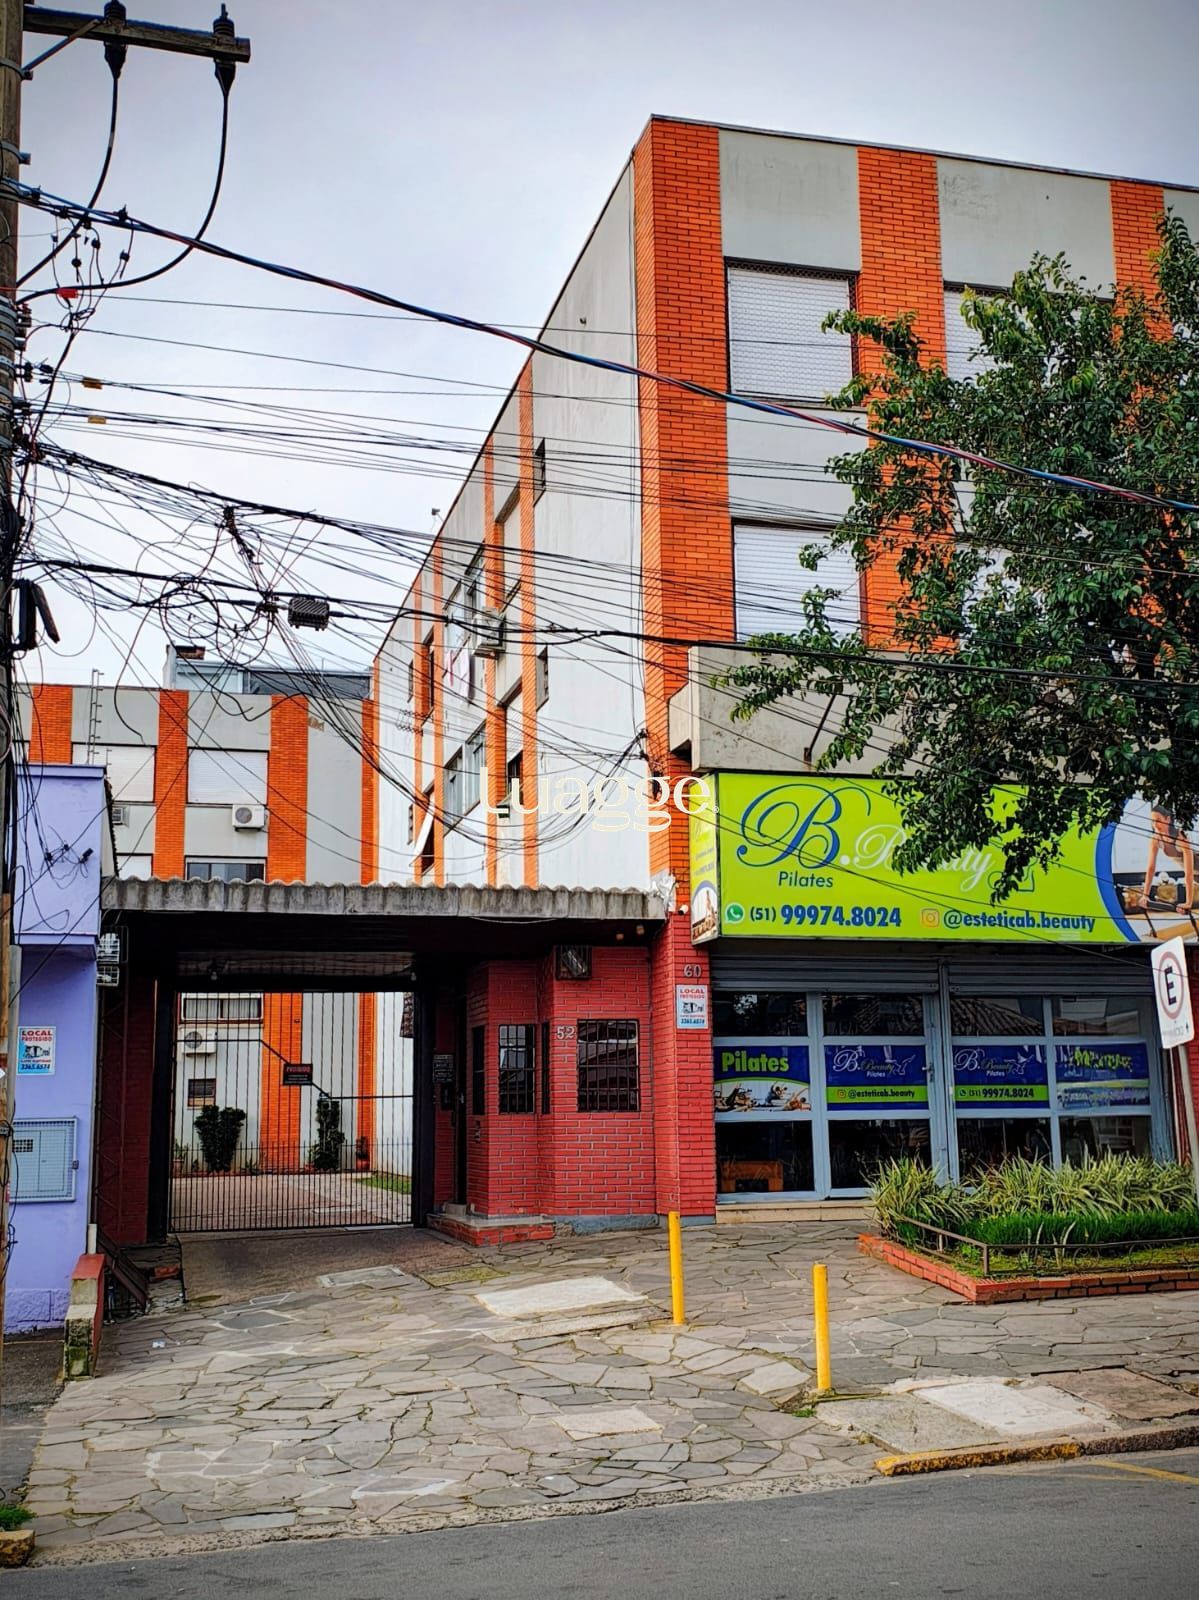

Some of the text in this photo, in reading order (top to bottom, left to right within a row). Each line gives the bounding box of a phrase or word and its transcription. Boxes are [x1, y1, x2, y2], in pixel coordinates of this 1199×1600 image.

[778, 870, 833, 888] Pilates
[750, 904, 902, 927] (51) 99974.8024
[943, 910, 1095, 933] @esteticab.beauty
[684, 963, 701, 978] 60
[1164, 966, 1177, 1006] E
[557, 1025, 575, 1040] 52
[721, 1050, 790, 1072] Pilates
[848, 1089, 915, 1098] @esteticab.beauty
[982, 1088, 1034, 1098] 99974.8024
